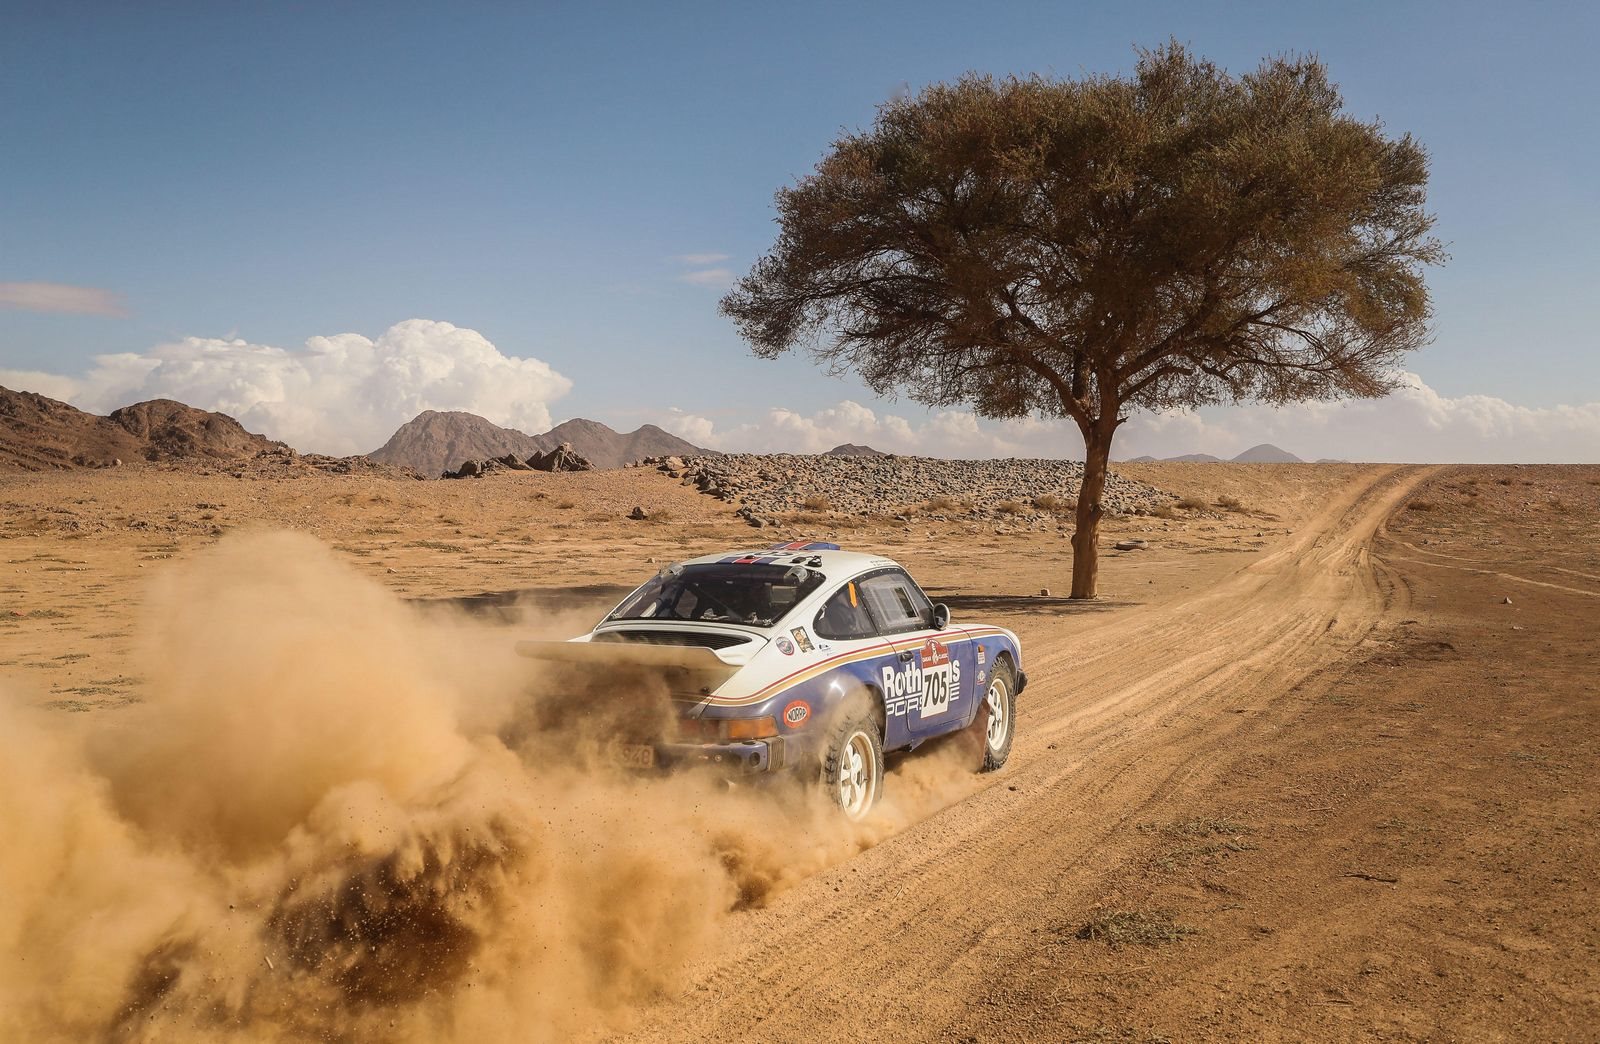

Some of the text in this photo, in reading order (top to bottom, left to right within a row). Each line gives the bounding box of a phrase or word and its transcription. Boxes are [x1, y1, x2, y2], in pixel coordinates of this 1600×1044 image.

[882, 659, 960, 699] Roths
[923, 671, 947, 708] 705
[886, 686, 960, 717] PORE
